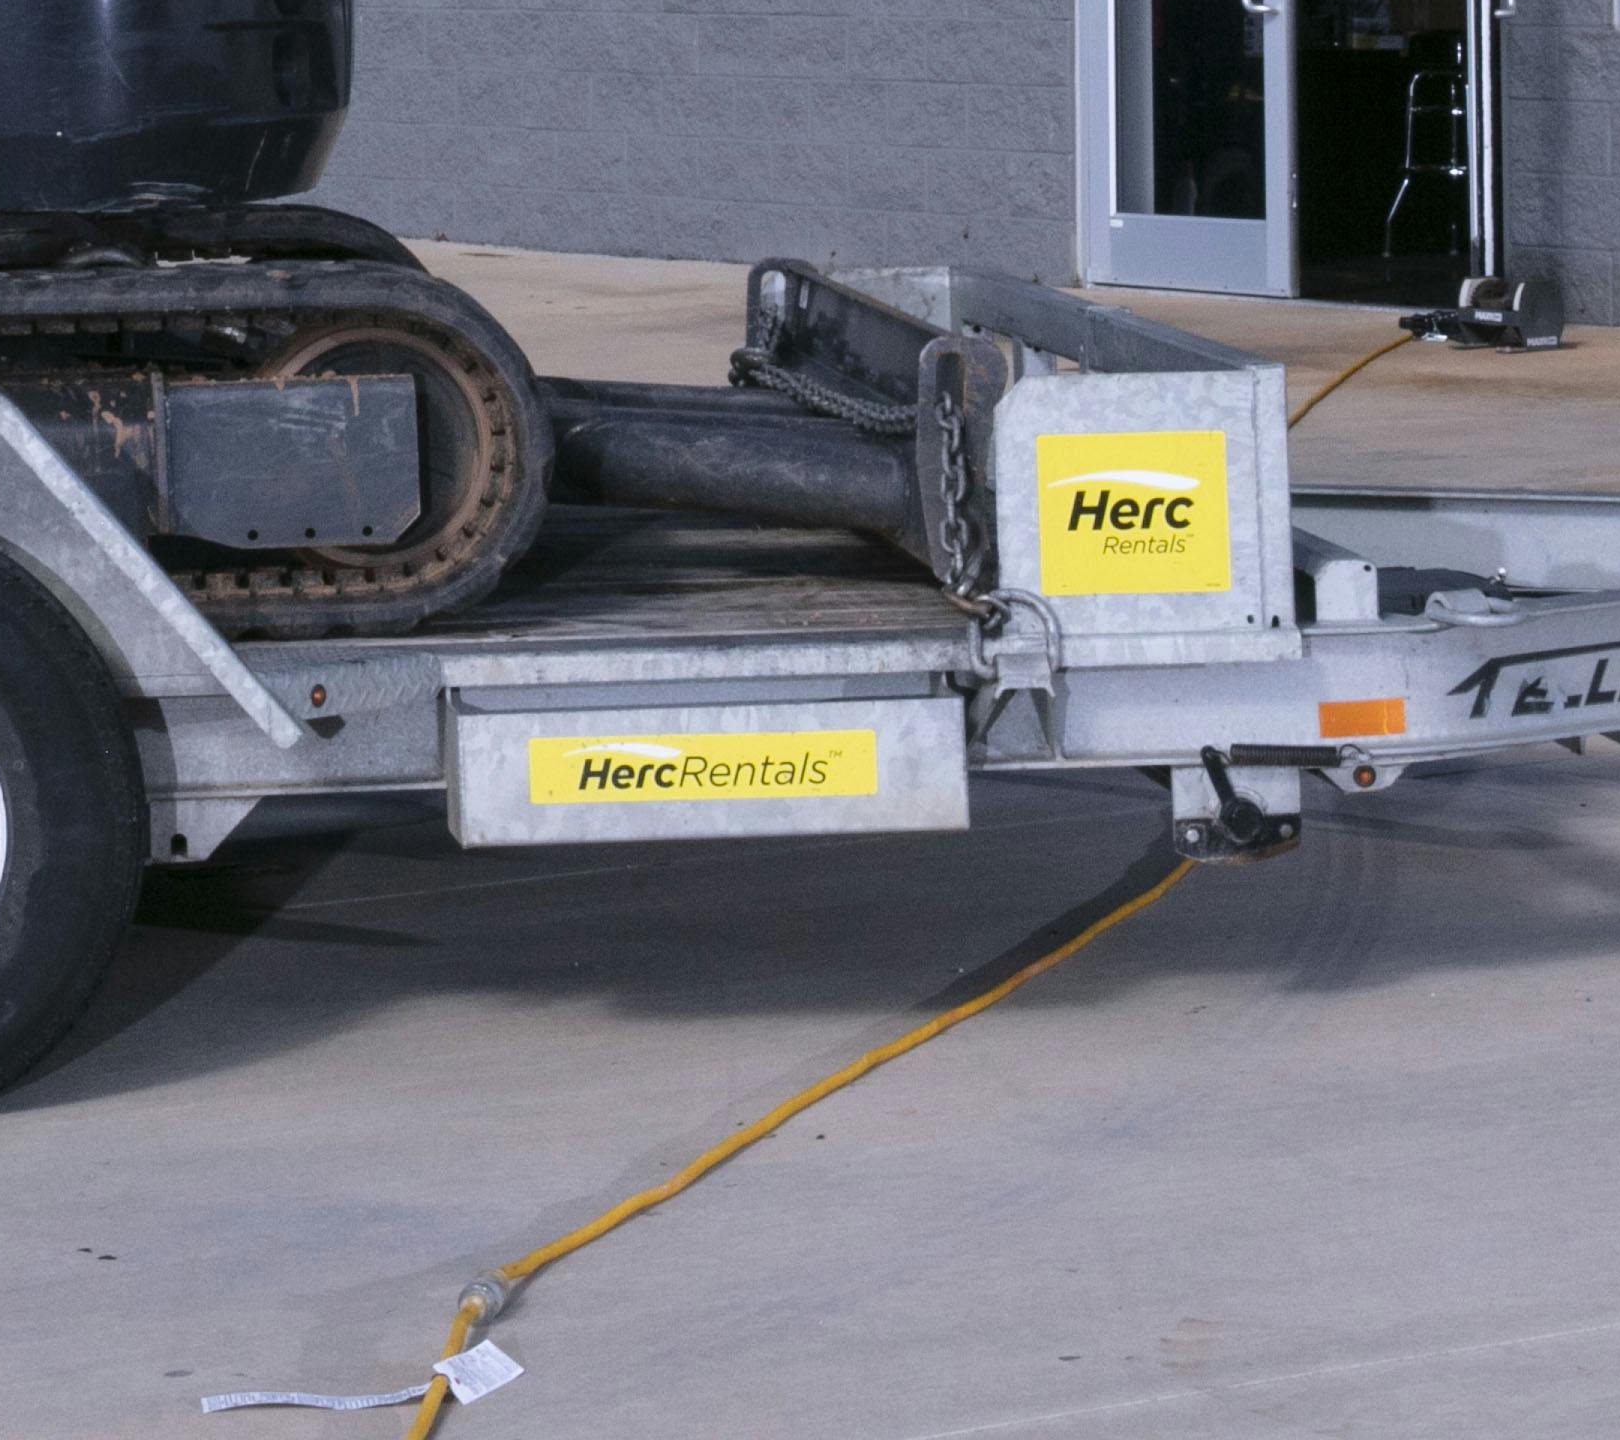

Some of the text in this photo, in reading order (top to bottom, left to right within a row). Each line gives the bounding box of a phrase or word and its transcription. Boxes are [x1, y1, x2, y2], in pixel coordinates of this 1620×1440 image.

[1067, 490, 1195, 531] Herc
[1102, 533, 1187, 555] Rentals
[578, 752, 829, 791] HercRentals
